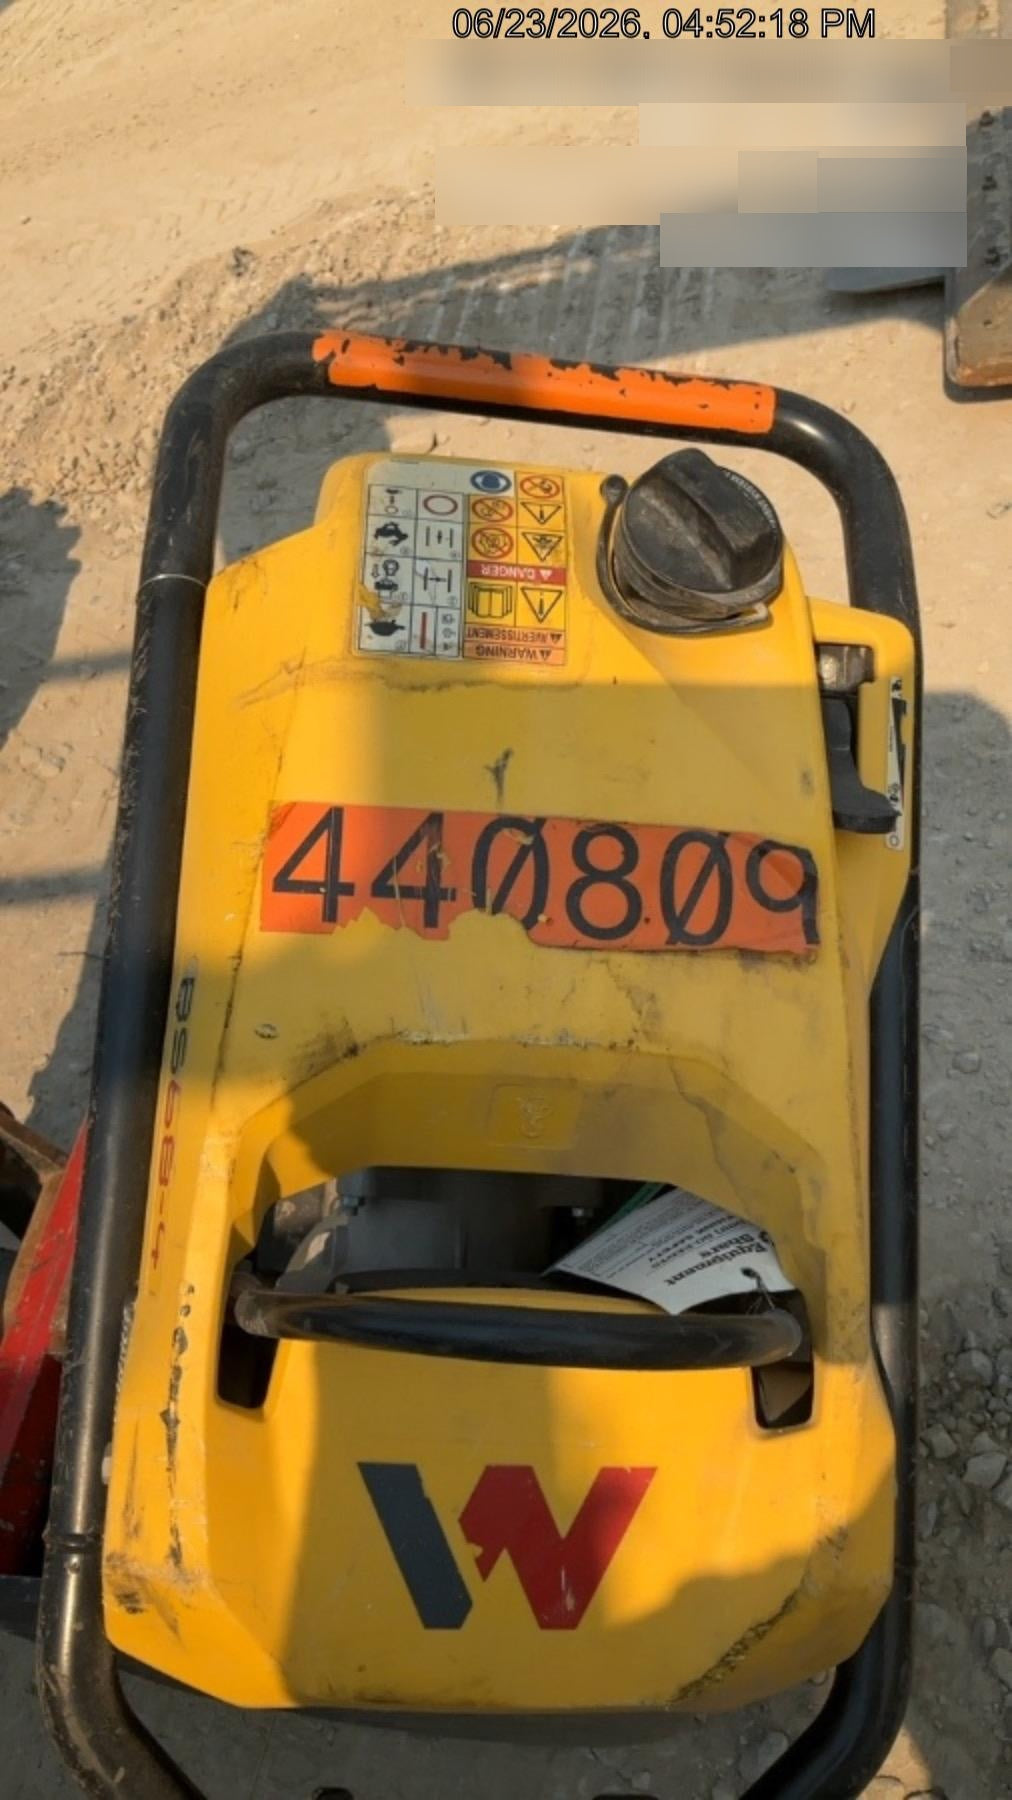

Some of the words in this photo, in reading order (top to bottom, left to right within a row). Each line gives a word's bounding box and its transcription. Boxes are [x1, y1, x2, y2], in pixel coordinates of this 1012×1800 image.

[481, 563, 535, 577] DANGER
[467, 626, 549, 643] AVERTISSEMENT
[475, 643, 537, 660] WARNING
[272, 805, 820, 946] 440809
[699, 1232, 755, 1259] Share
[664, 1242, 768, 1286] Equipment
